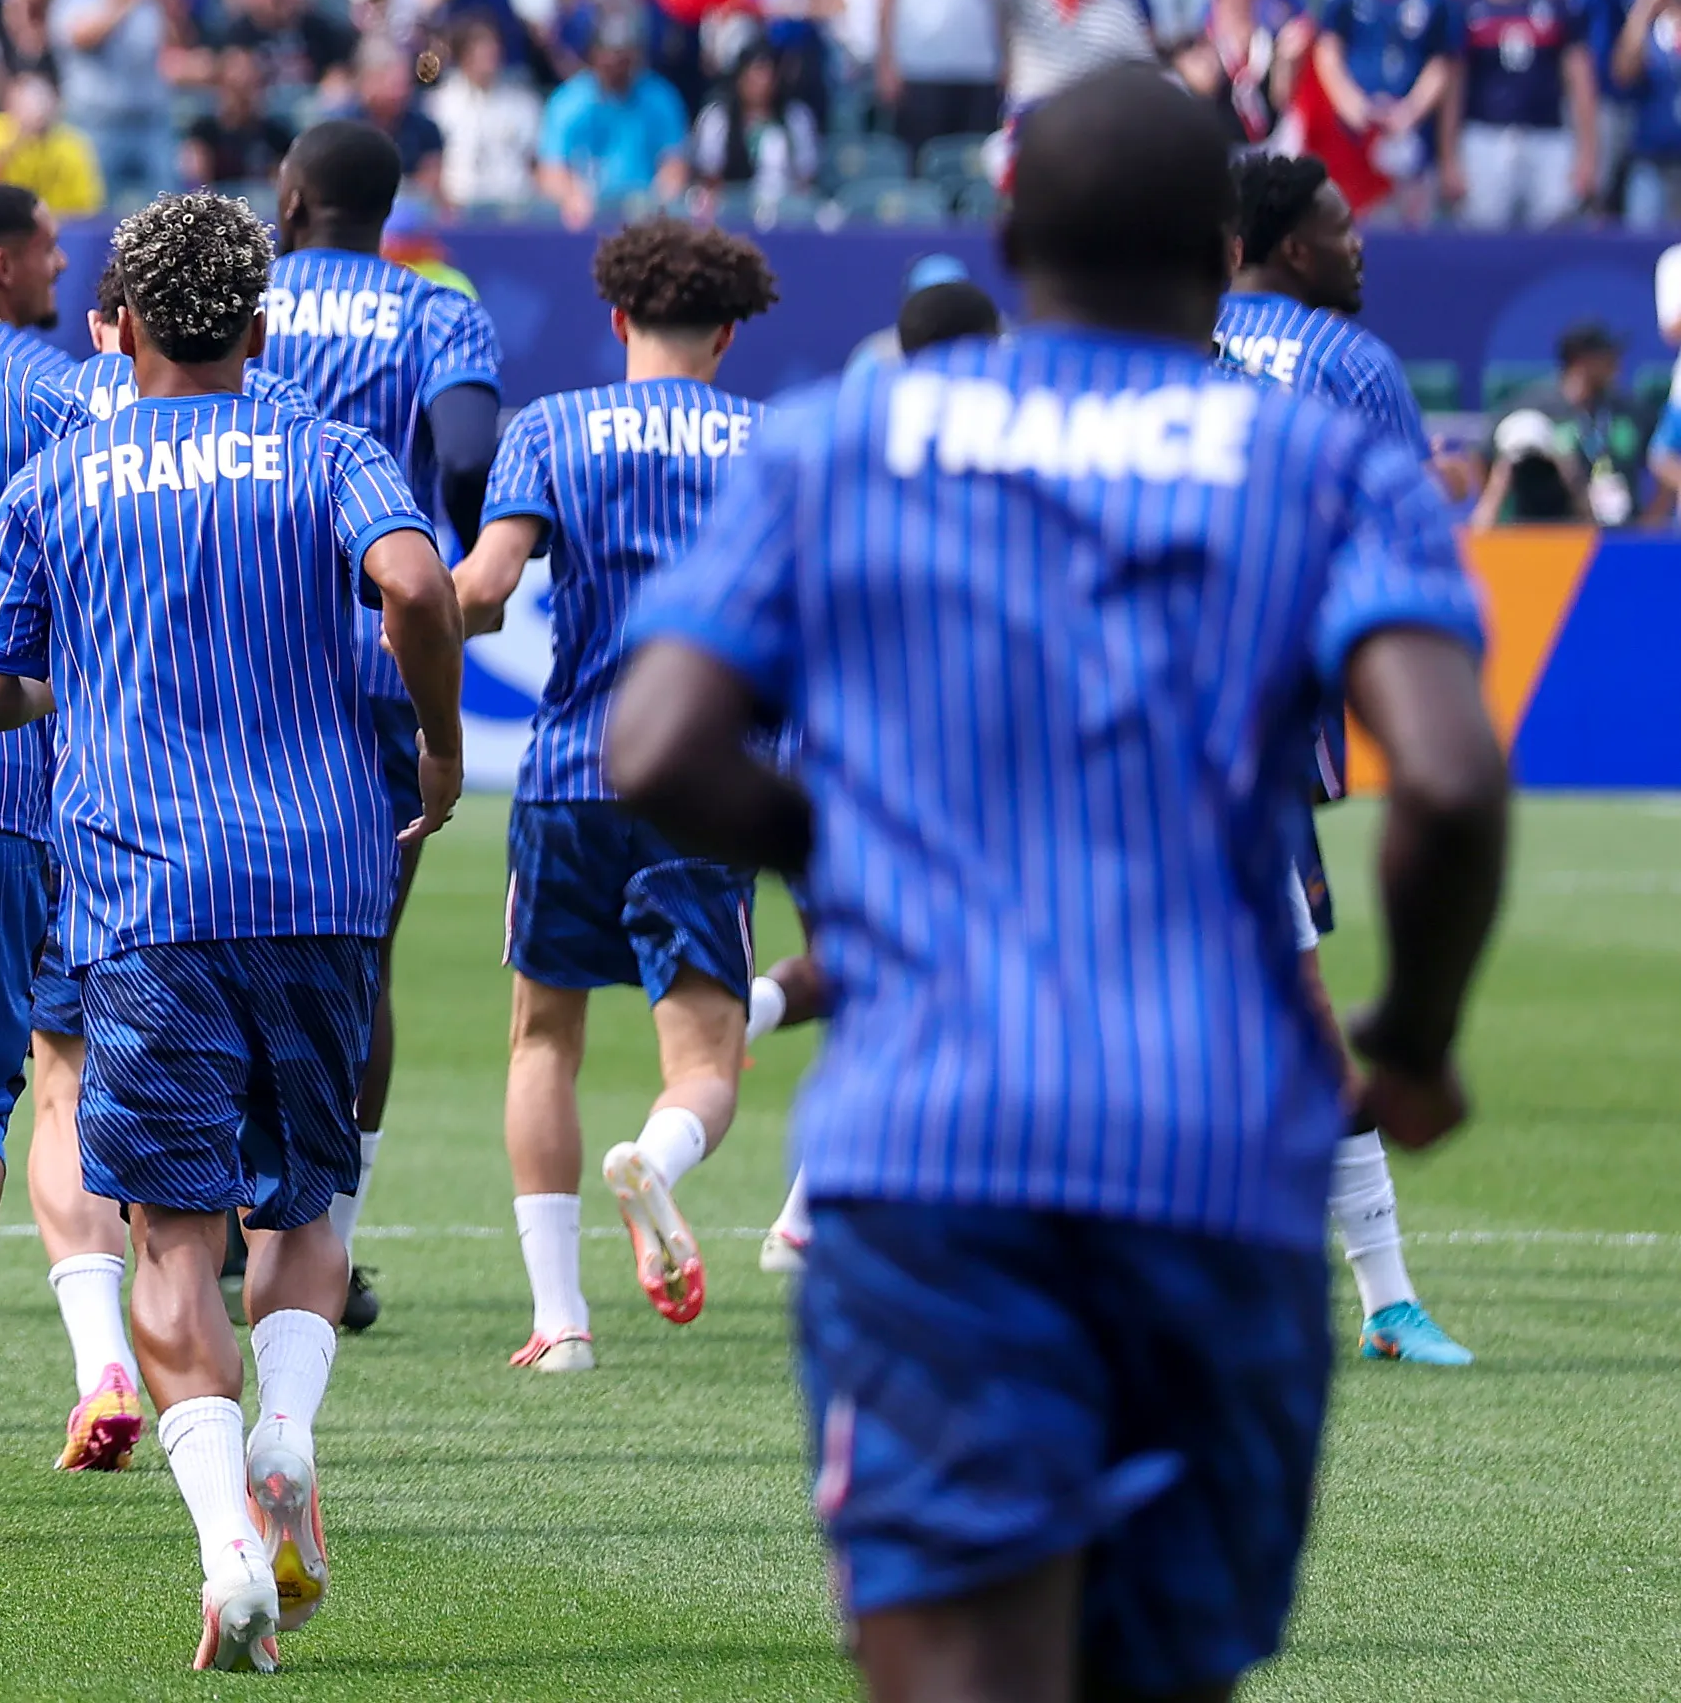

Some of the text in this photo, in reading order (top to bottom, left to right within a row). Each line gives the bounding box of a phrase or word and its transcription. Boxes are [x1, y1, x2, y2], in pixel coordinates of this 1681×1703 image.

[587, 404, 752, 458] FRANCE
[886, 371, 1257, 488] FRANCE
[82, 430, 282, 507] FRANCE
